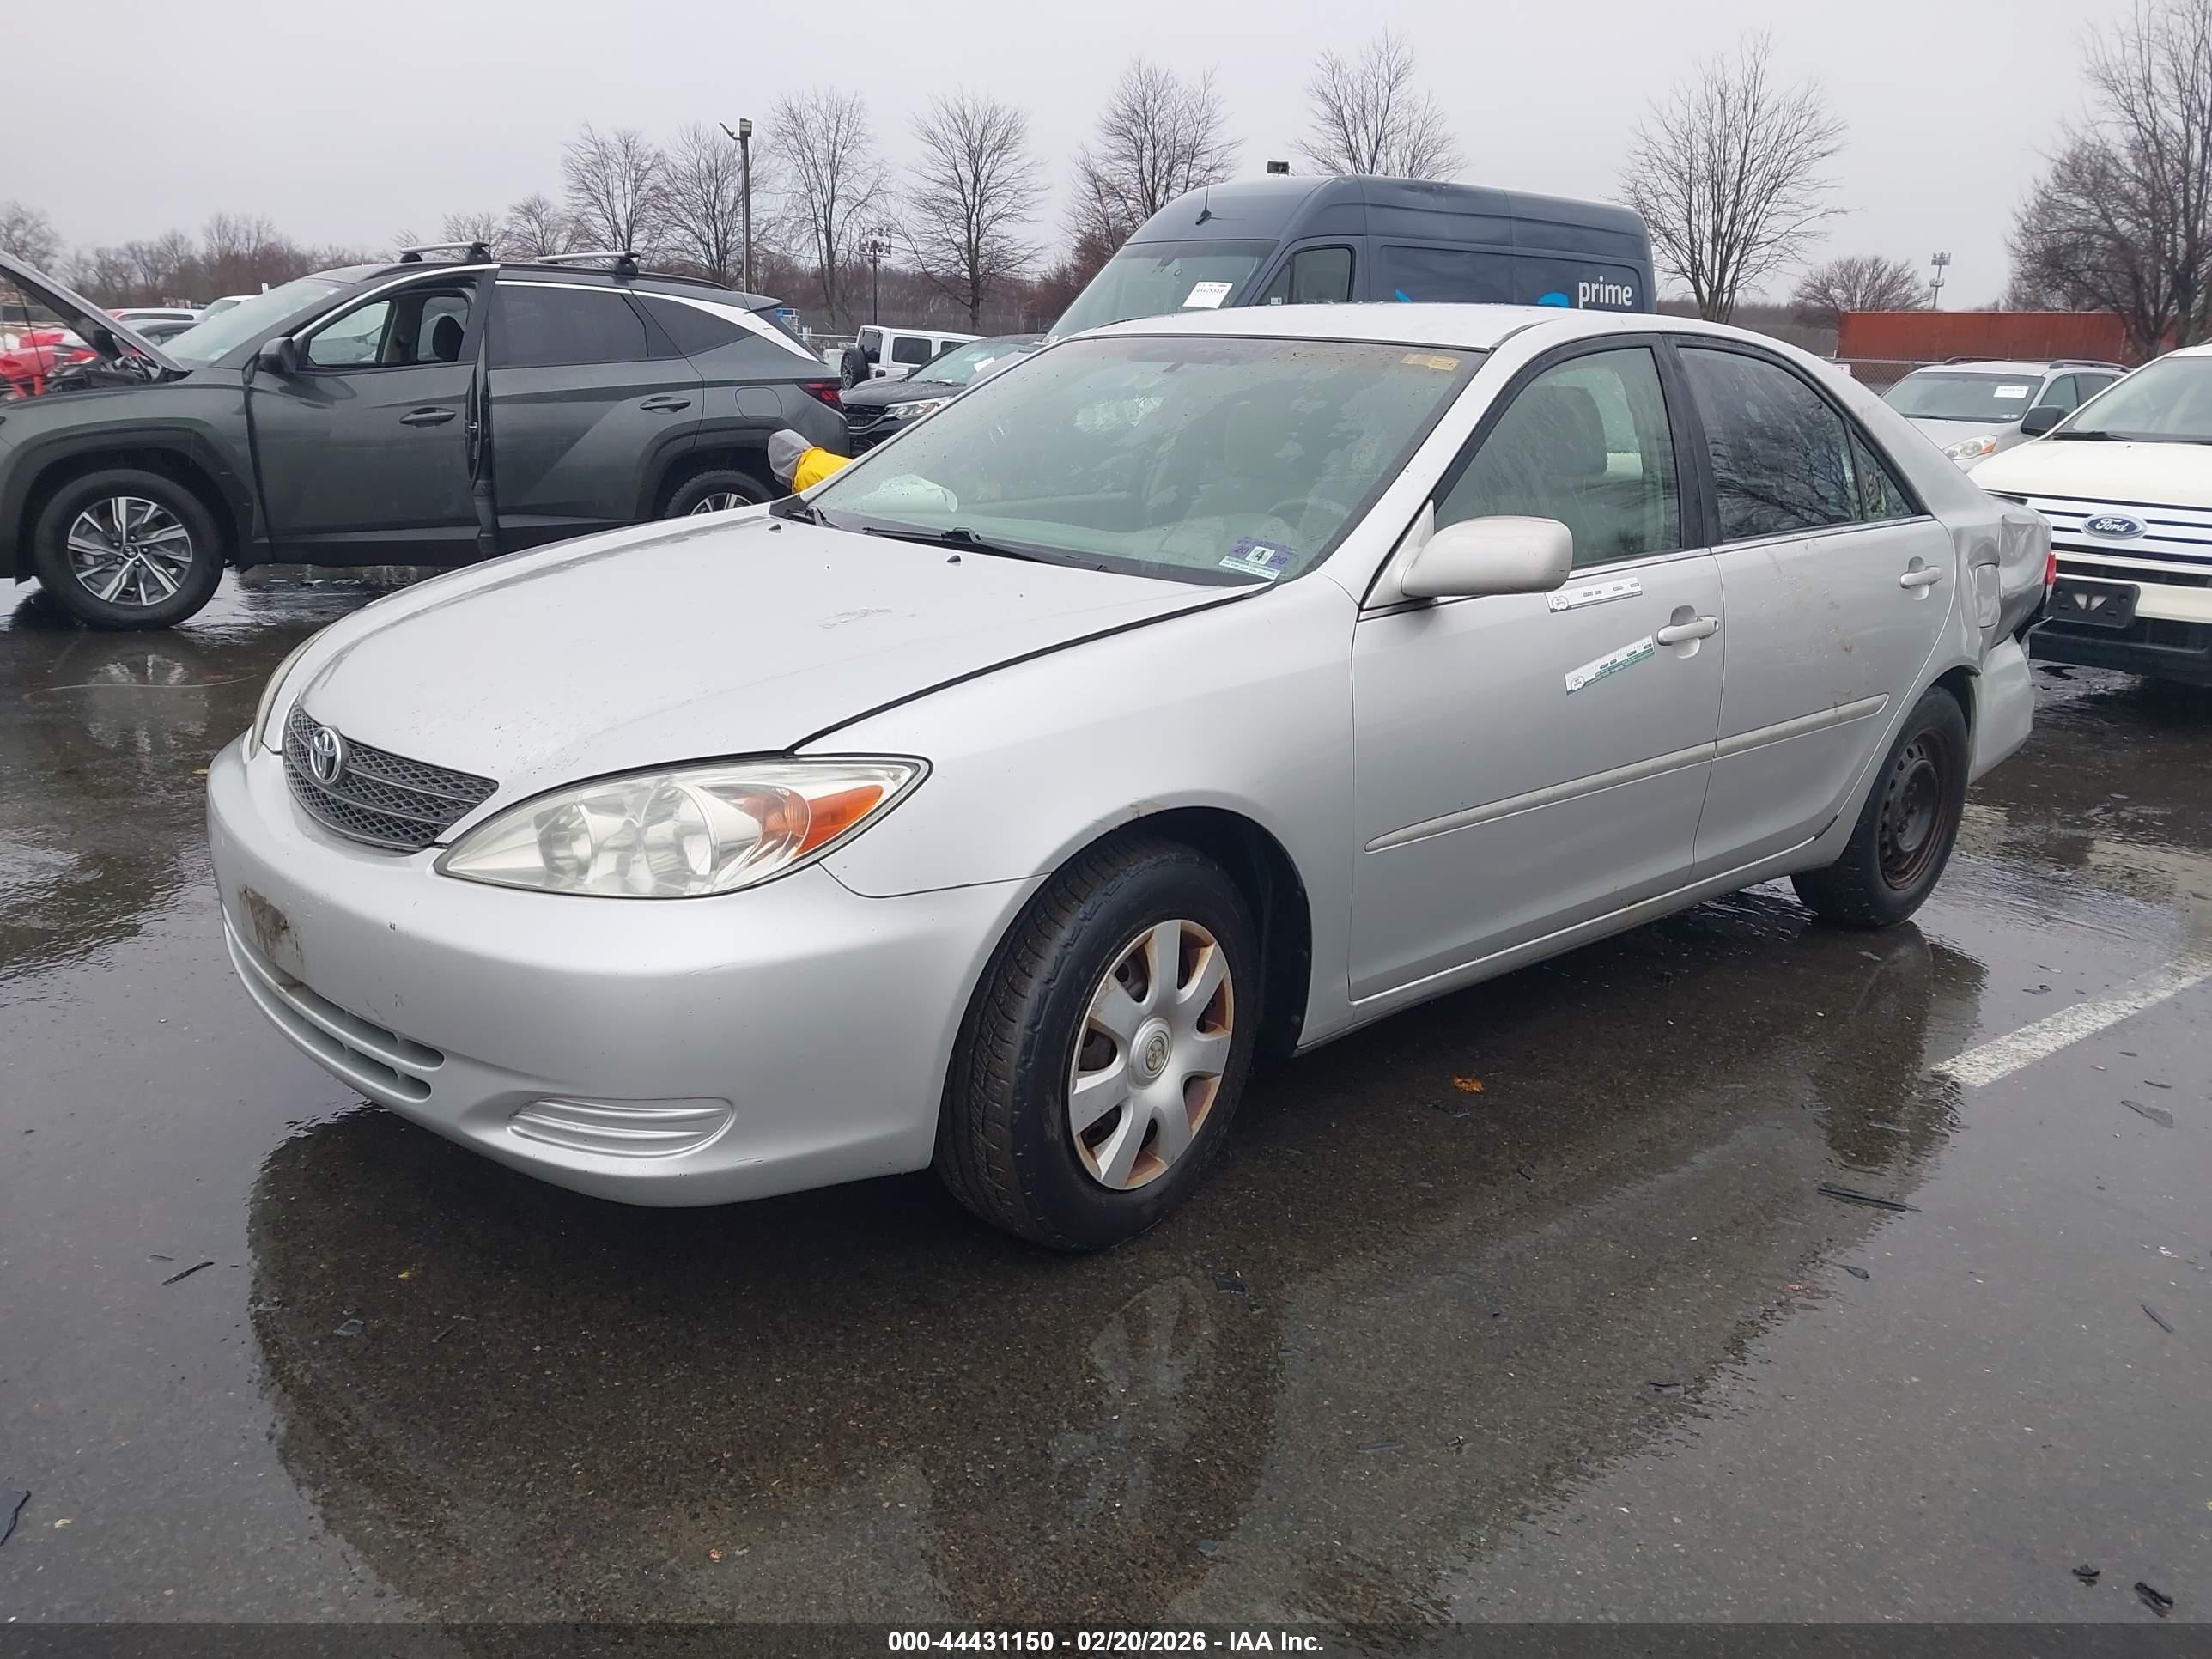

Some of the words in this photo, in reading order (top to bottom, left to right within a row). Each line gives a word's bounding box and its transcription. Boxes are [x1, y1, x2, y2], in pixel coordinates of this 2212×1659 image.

[1578, 275, 1633, 309] prime
[2095, 517, 2130, 532] Ford
[1235, 545, 1250, 555] 20
[1255, 550, 1267, 562] 4
